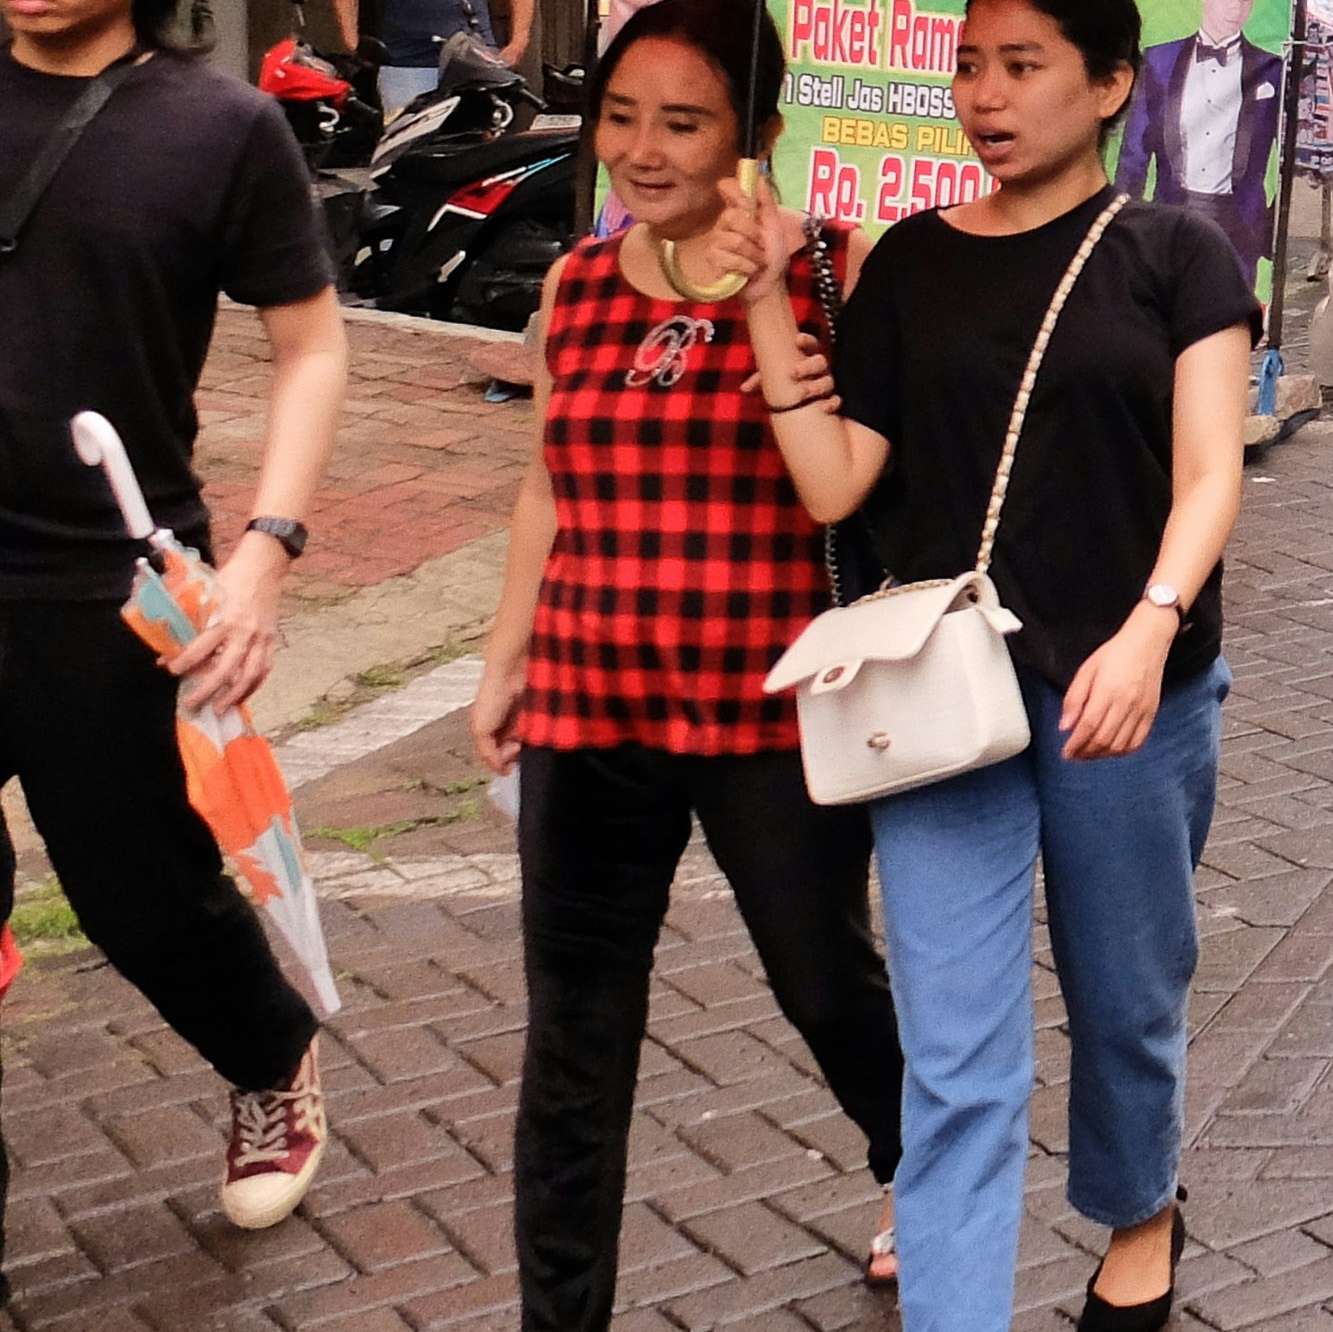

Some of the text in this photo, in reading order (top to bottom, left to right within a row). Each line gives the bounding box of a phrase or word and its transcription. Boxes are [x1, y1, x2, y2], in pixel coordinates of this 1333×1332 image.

[798, 72, 844, 109] Stell
[848, 78, 883, 112] Jas
[822, 116, 909, 150] BEBAS
[809, 148, 1001, 222] Rp. 2.500
